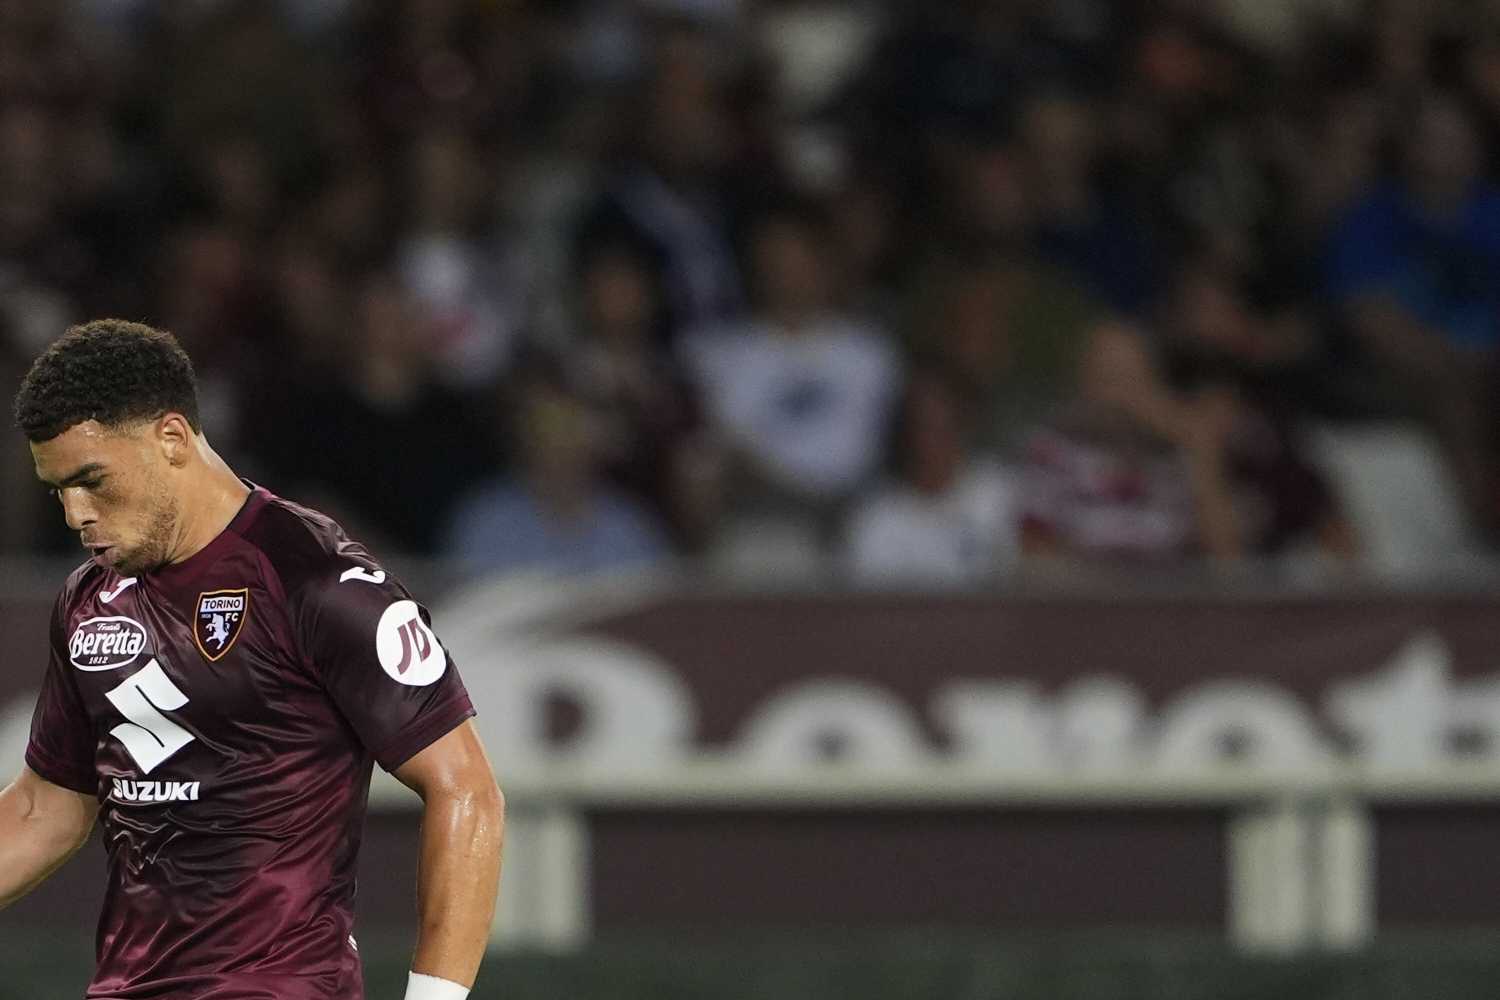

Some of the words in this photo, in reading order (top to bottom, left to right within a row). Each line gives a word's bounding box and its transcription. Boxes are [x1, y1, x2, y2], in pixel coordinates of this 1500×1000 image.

[204, 599, 241, 610] TORINO
[225, 612, 239, 622] FC
[70, 628, 143, 659] Beretta
[396, 617, 432, 676] JD
[88, 656, 108, 665] 1812
[112, 777, 201, 801] SUZUKI
